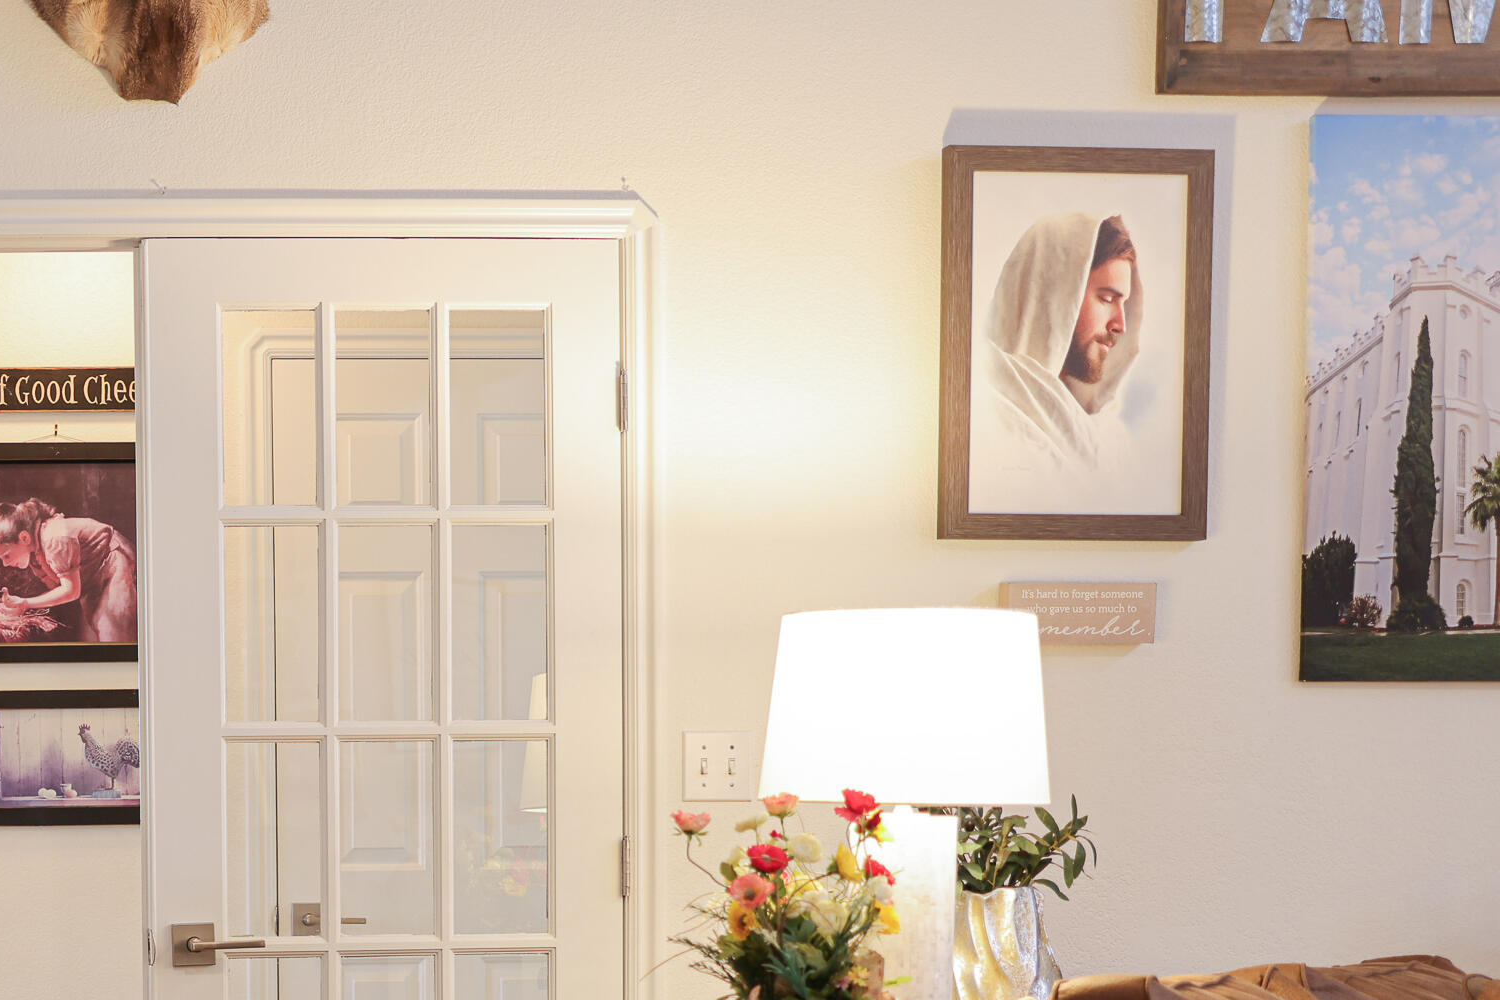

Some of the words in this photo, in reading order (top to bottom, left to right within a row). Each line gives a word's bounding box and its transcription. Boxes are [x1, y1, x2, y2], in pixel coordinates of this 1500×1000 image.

[15, 374, 78, 406] Good
[83, 373, 136, 406] Chee
[1036, 588, 1058, 599] hard
[1060, 590, 1070, 599] to
[1072, 588, 1099, 601] forget
[1100, 591, 1144, 599] someone
[1027, 603, 1048, 614] who
[1049, 605, 1071, 616] gave
[1072, 606, 1084, 614] us
[1085, 606, 1096, 614] so
[1098, 603, 1125, 613] much
[1127, 604, 1137, 613] to
[1039, 615, 1151, 636] member.
